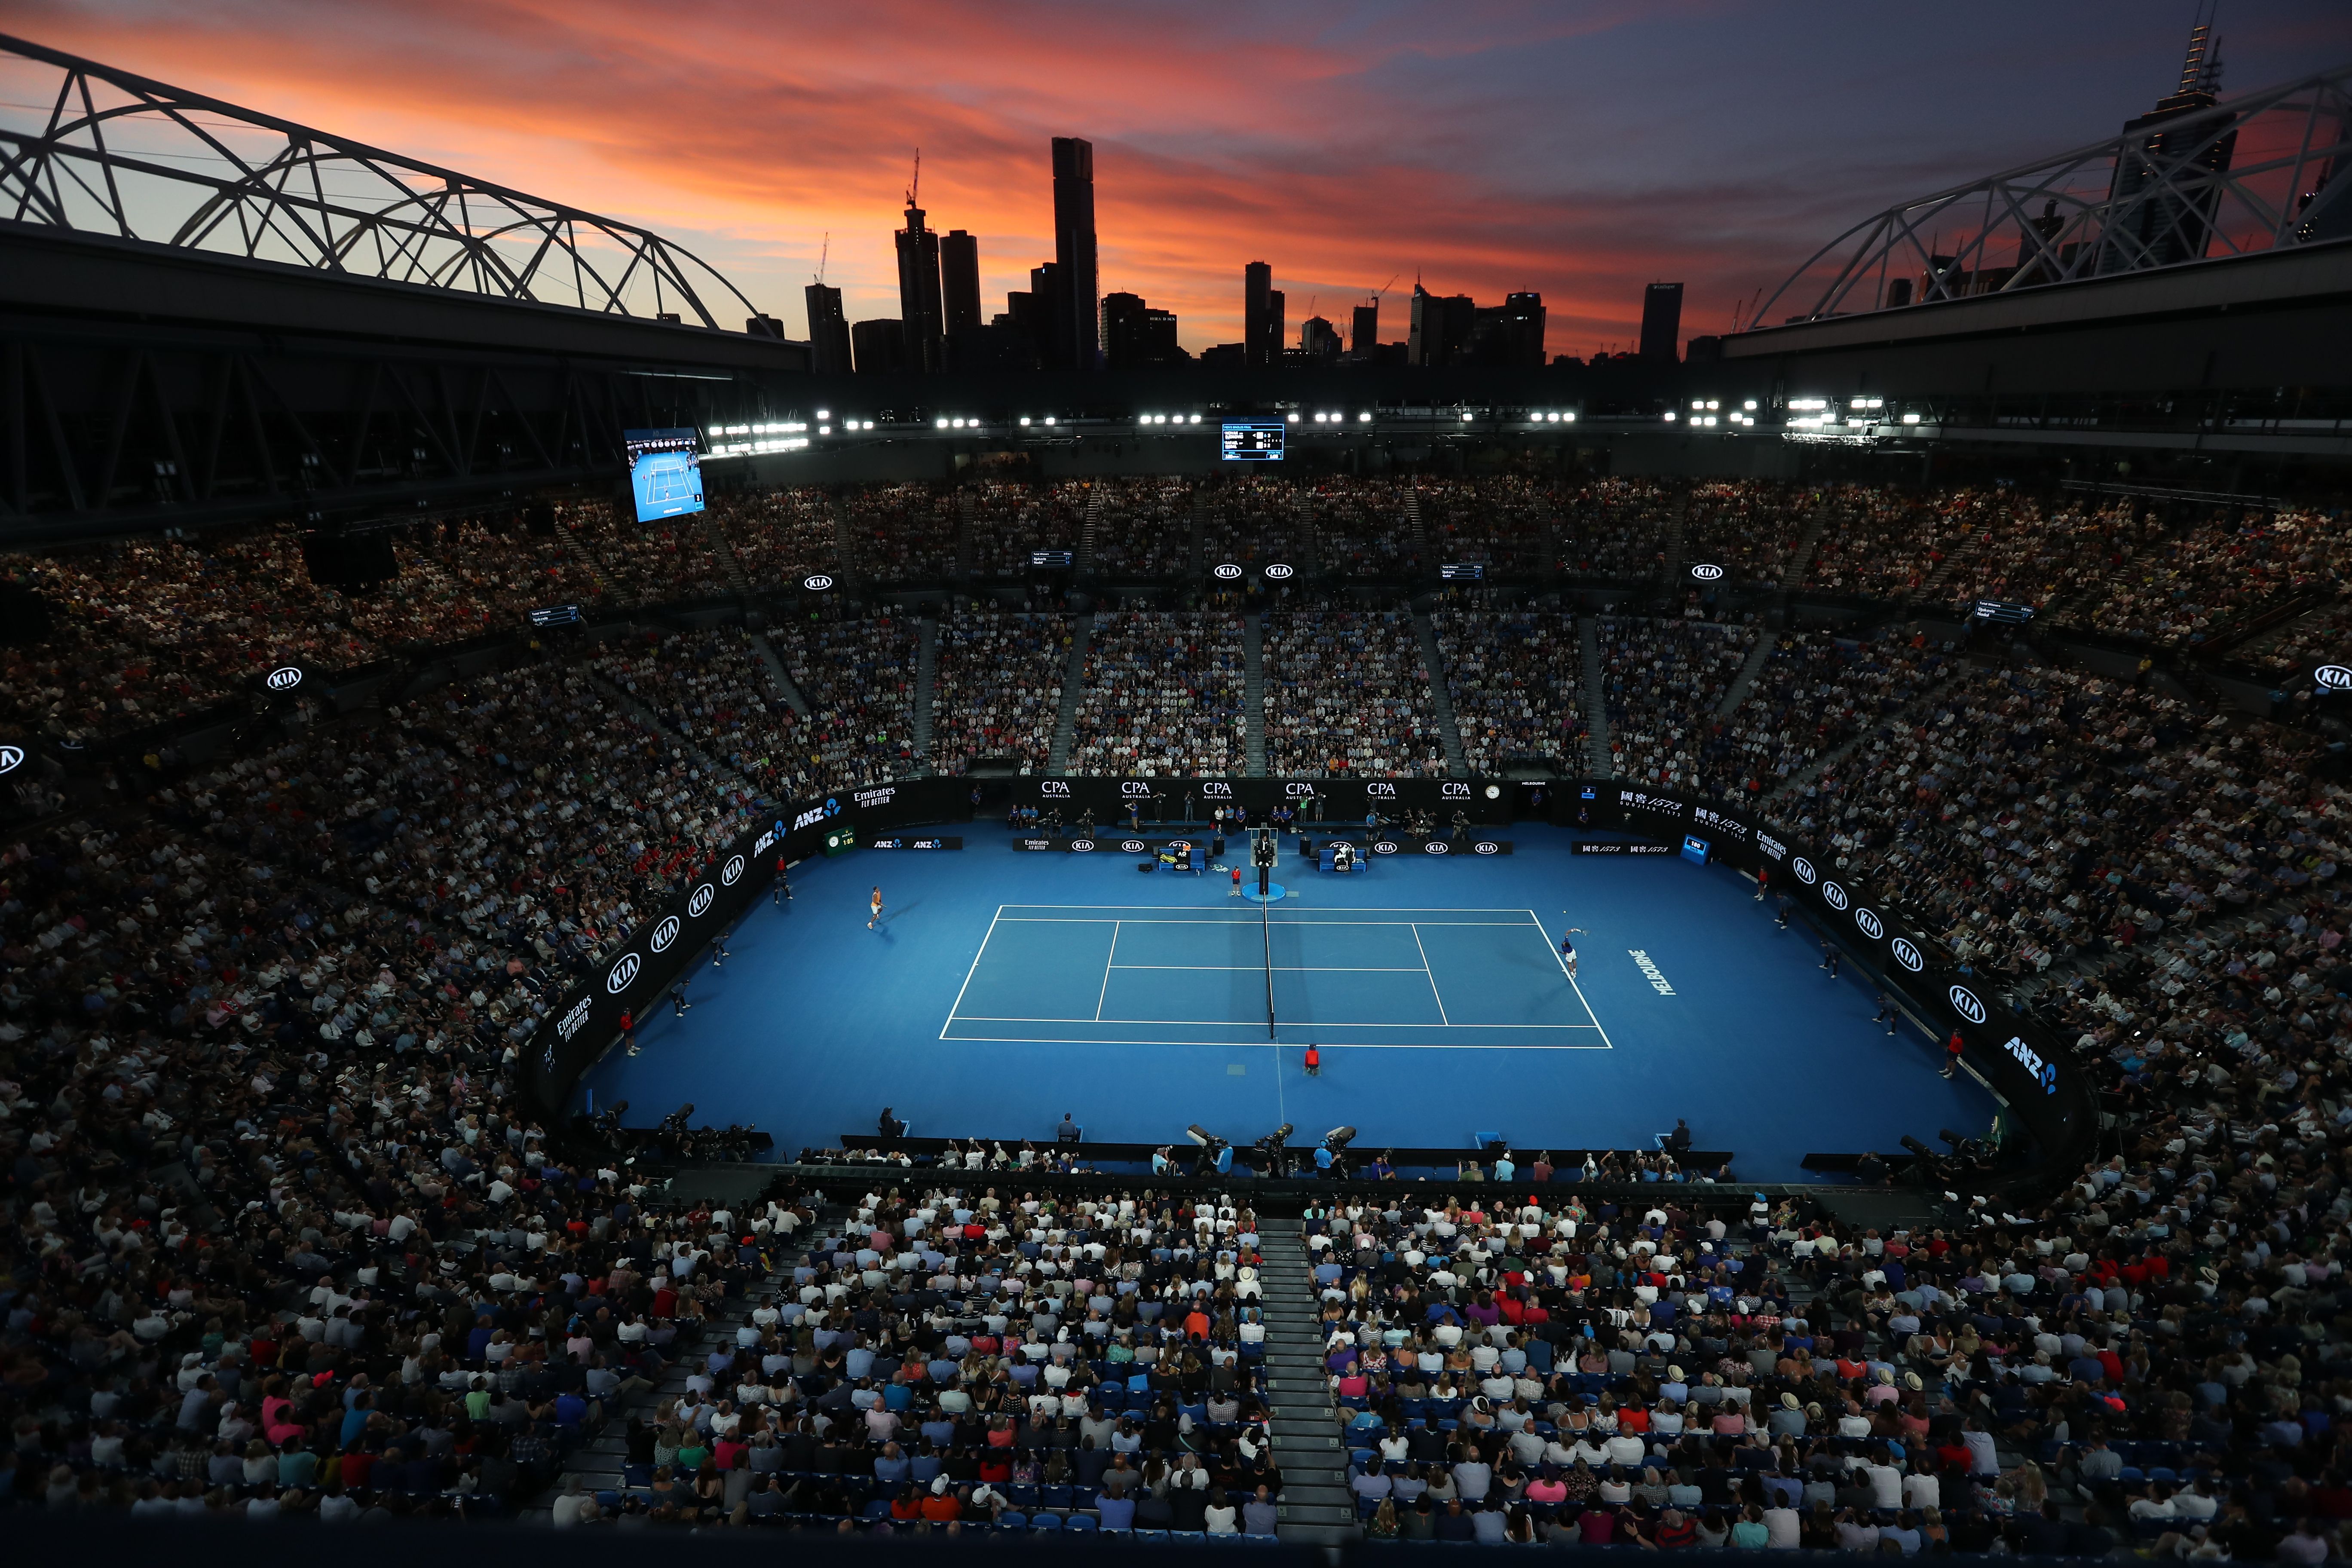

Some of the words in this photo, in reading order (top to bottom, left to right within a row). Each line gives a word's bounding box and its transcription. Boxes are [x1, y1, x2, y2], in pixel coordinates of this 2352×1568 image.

[1697, 567, 1717, 576] KIA
[809, 578, 828, 587] KIA
[273, 671, 297, 687] KIA
[2321, 668, 2350, 687] KIA
[854, 787, 895, 801] Emirates
[1041, 781, 1069, 793] CPA
[1122, 782, 1150, 793] CPA
[1204, 783, 1232, 794] CPA
[1286, 783, 1314, 794] CPA
[1367, 783, 1396, 794] CPA
[1442, 783, 1471, 795] CPA
[861, 799, 871, 808] FLY
[871, 796, 890, 806] BETTER
[1620, 801, 1655, 811] GUOJIAO
[794, 806, 824, 831] ANZ
[1694, 818, 1726, 832] GUOJIAO
[753, 830, 774, 858] ANZ
[843, 837, 853, 845] 1:05
[1757, 830, 1787, 854] Emirates
[1767, 847, 1782, 861] BETTER
[725, 859, 741, 882] KIA
[1797, 860, 1811, 881] KIA
[692, 888, 710, 913] KIA
[1826, 884, 1843, 907] KIA
[1859, 911, 1877, 936] KIA
[655, 921, 676, 949] KIA
[1896, 940, 1916, 969] KIA
[612, 959, 636, 989] KIA
[1628, 949, 1676, 995] MELBOURNE
[1955, 989, 1978, 1020] KIA
[557, 995, 592, 1036] Emirates
[571, 1010, 588, 1034] BETTER
[2004, 1036, 2043, 1080] ANZ
